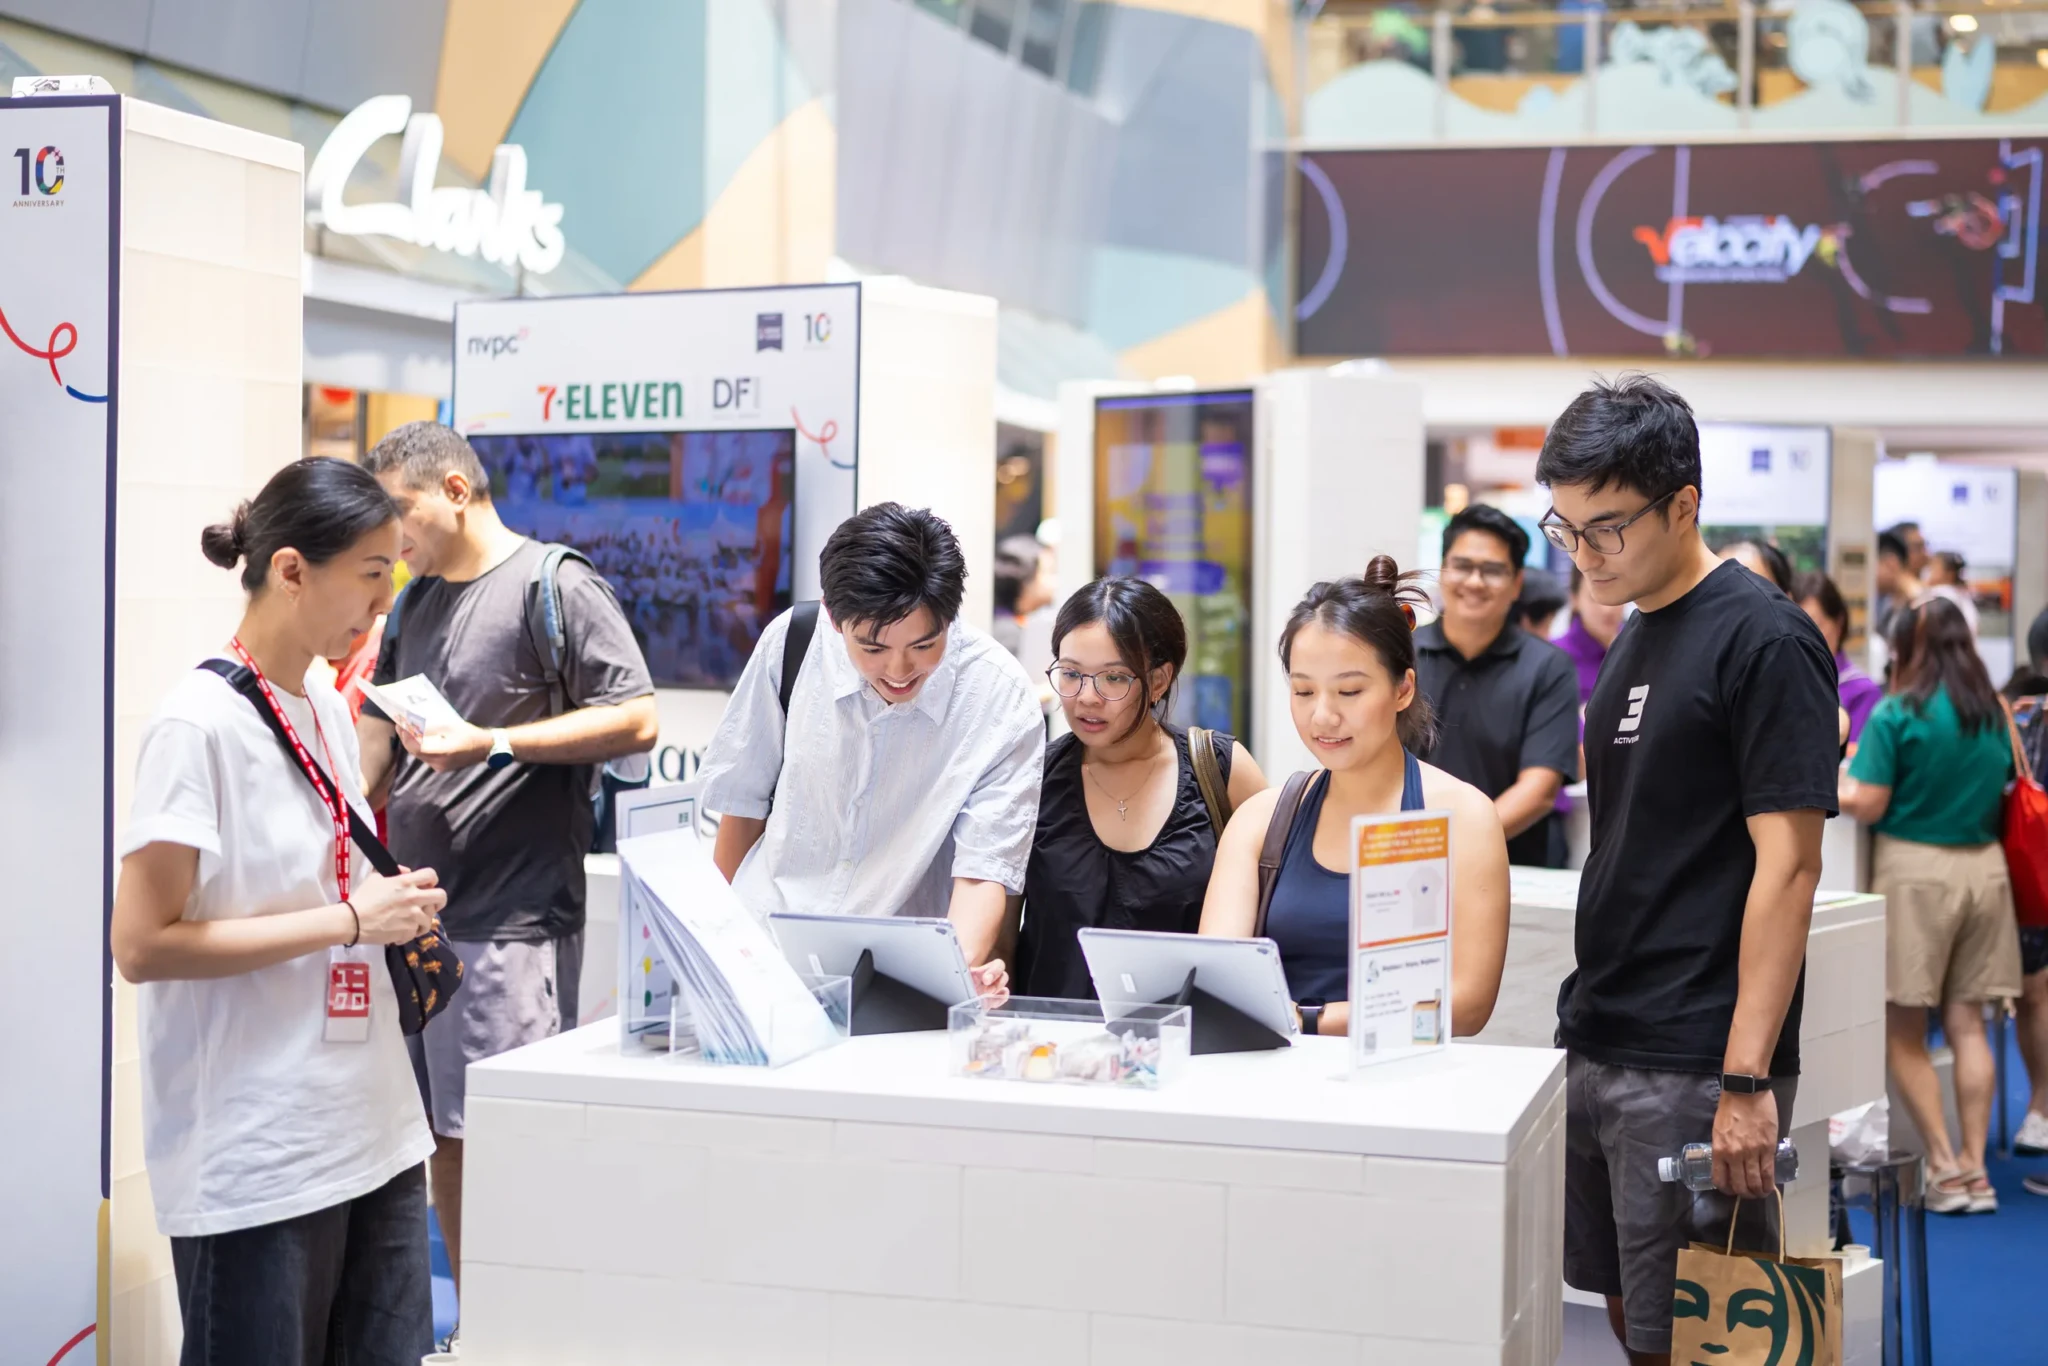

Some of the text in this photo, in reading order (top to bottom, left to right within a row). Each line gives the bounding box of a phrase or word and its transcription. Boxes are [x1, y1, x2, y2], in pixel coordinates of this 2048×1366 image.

[13, 145, 65, 196] 10
[12, 199, 65, 208] ANNIVERSARY
[467, 335, 519, 361] nvpc
